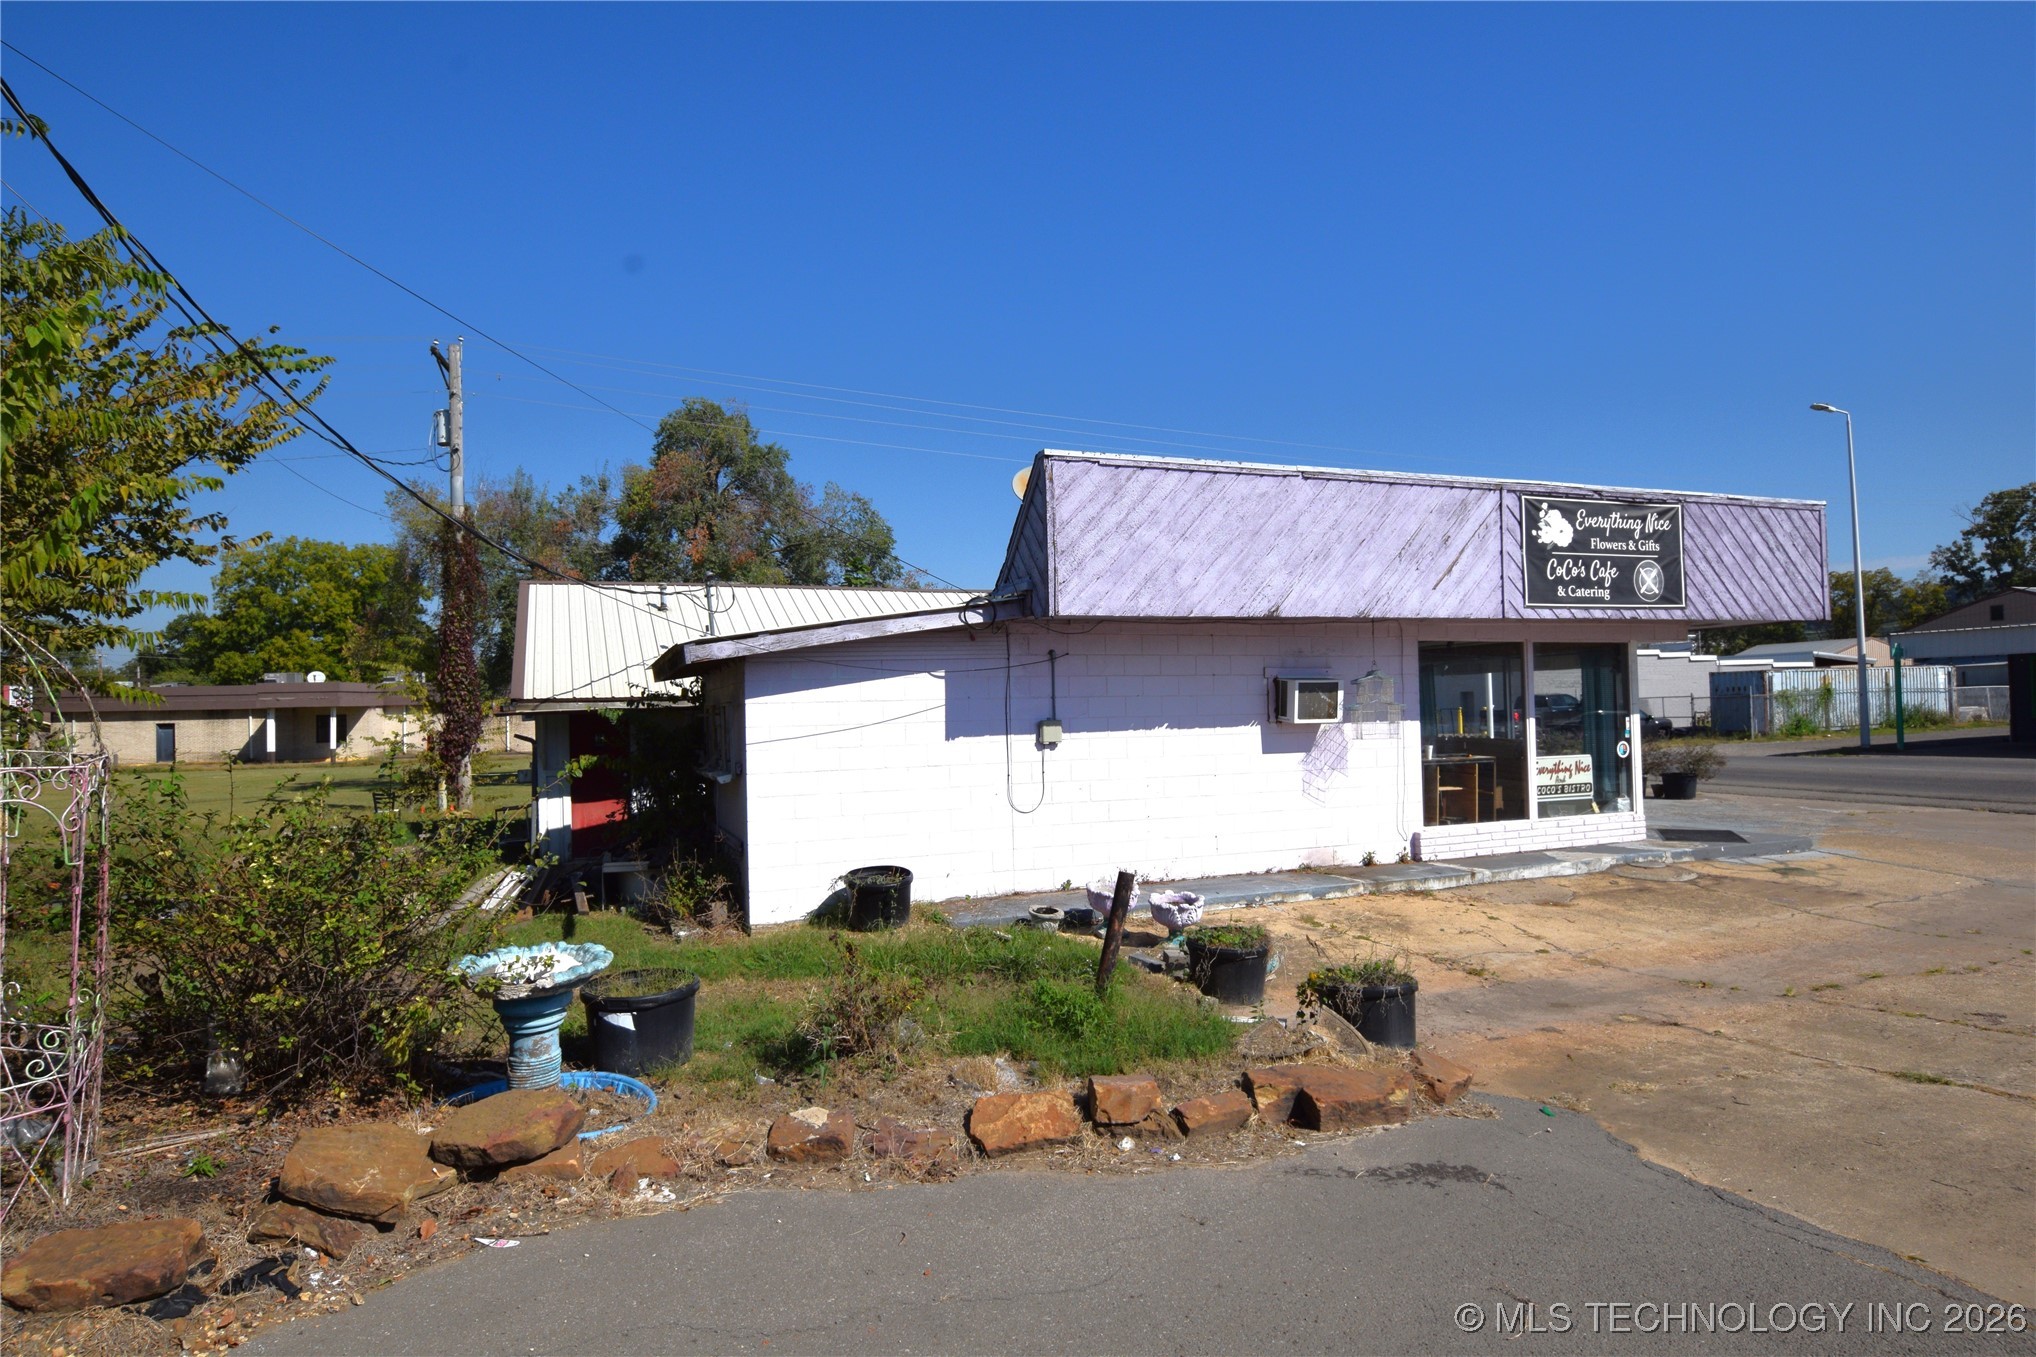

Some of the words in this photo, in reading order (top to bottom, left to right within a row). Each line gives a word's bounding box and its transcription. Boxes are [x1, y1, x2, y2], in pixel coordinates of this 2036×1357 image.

[1576, 509, 1643, 539] Everything
[1645, 513, 1671, 533] Nice
[1590, 538, 1626, 550] Flowers
[1628, 540, 1637, 550] &
[1638, 540, 1660, 551] Gifts
[1547, 558, 1585, 580] CoCo's
[1590, 559, 1619, 587] Cafe
[1557, 585, 1567, 597] &
[1568, 585, 1610, 600] Catering
[1574, 760, 1591, 776] Nice
[1564, 784, 1591, 793] BISTRO
